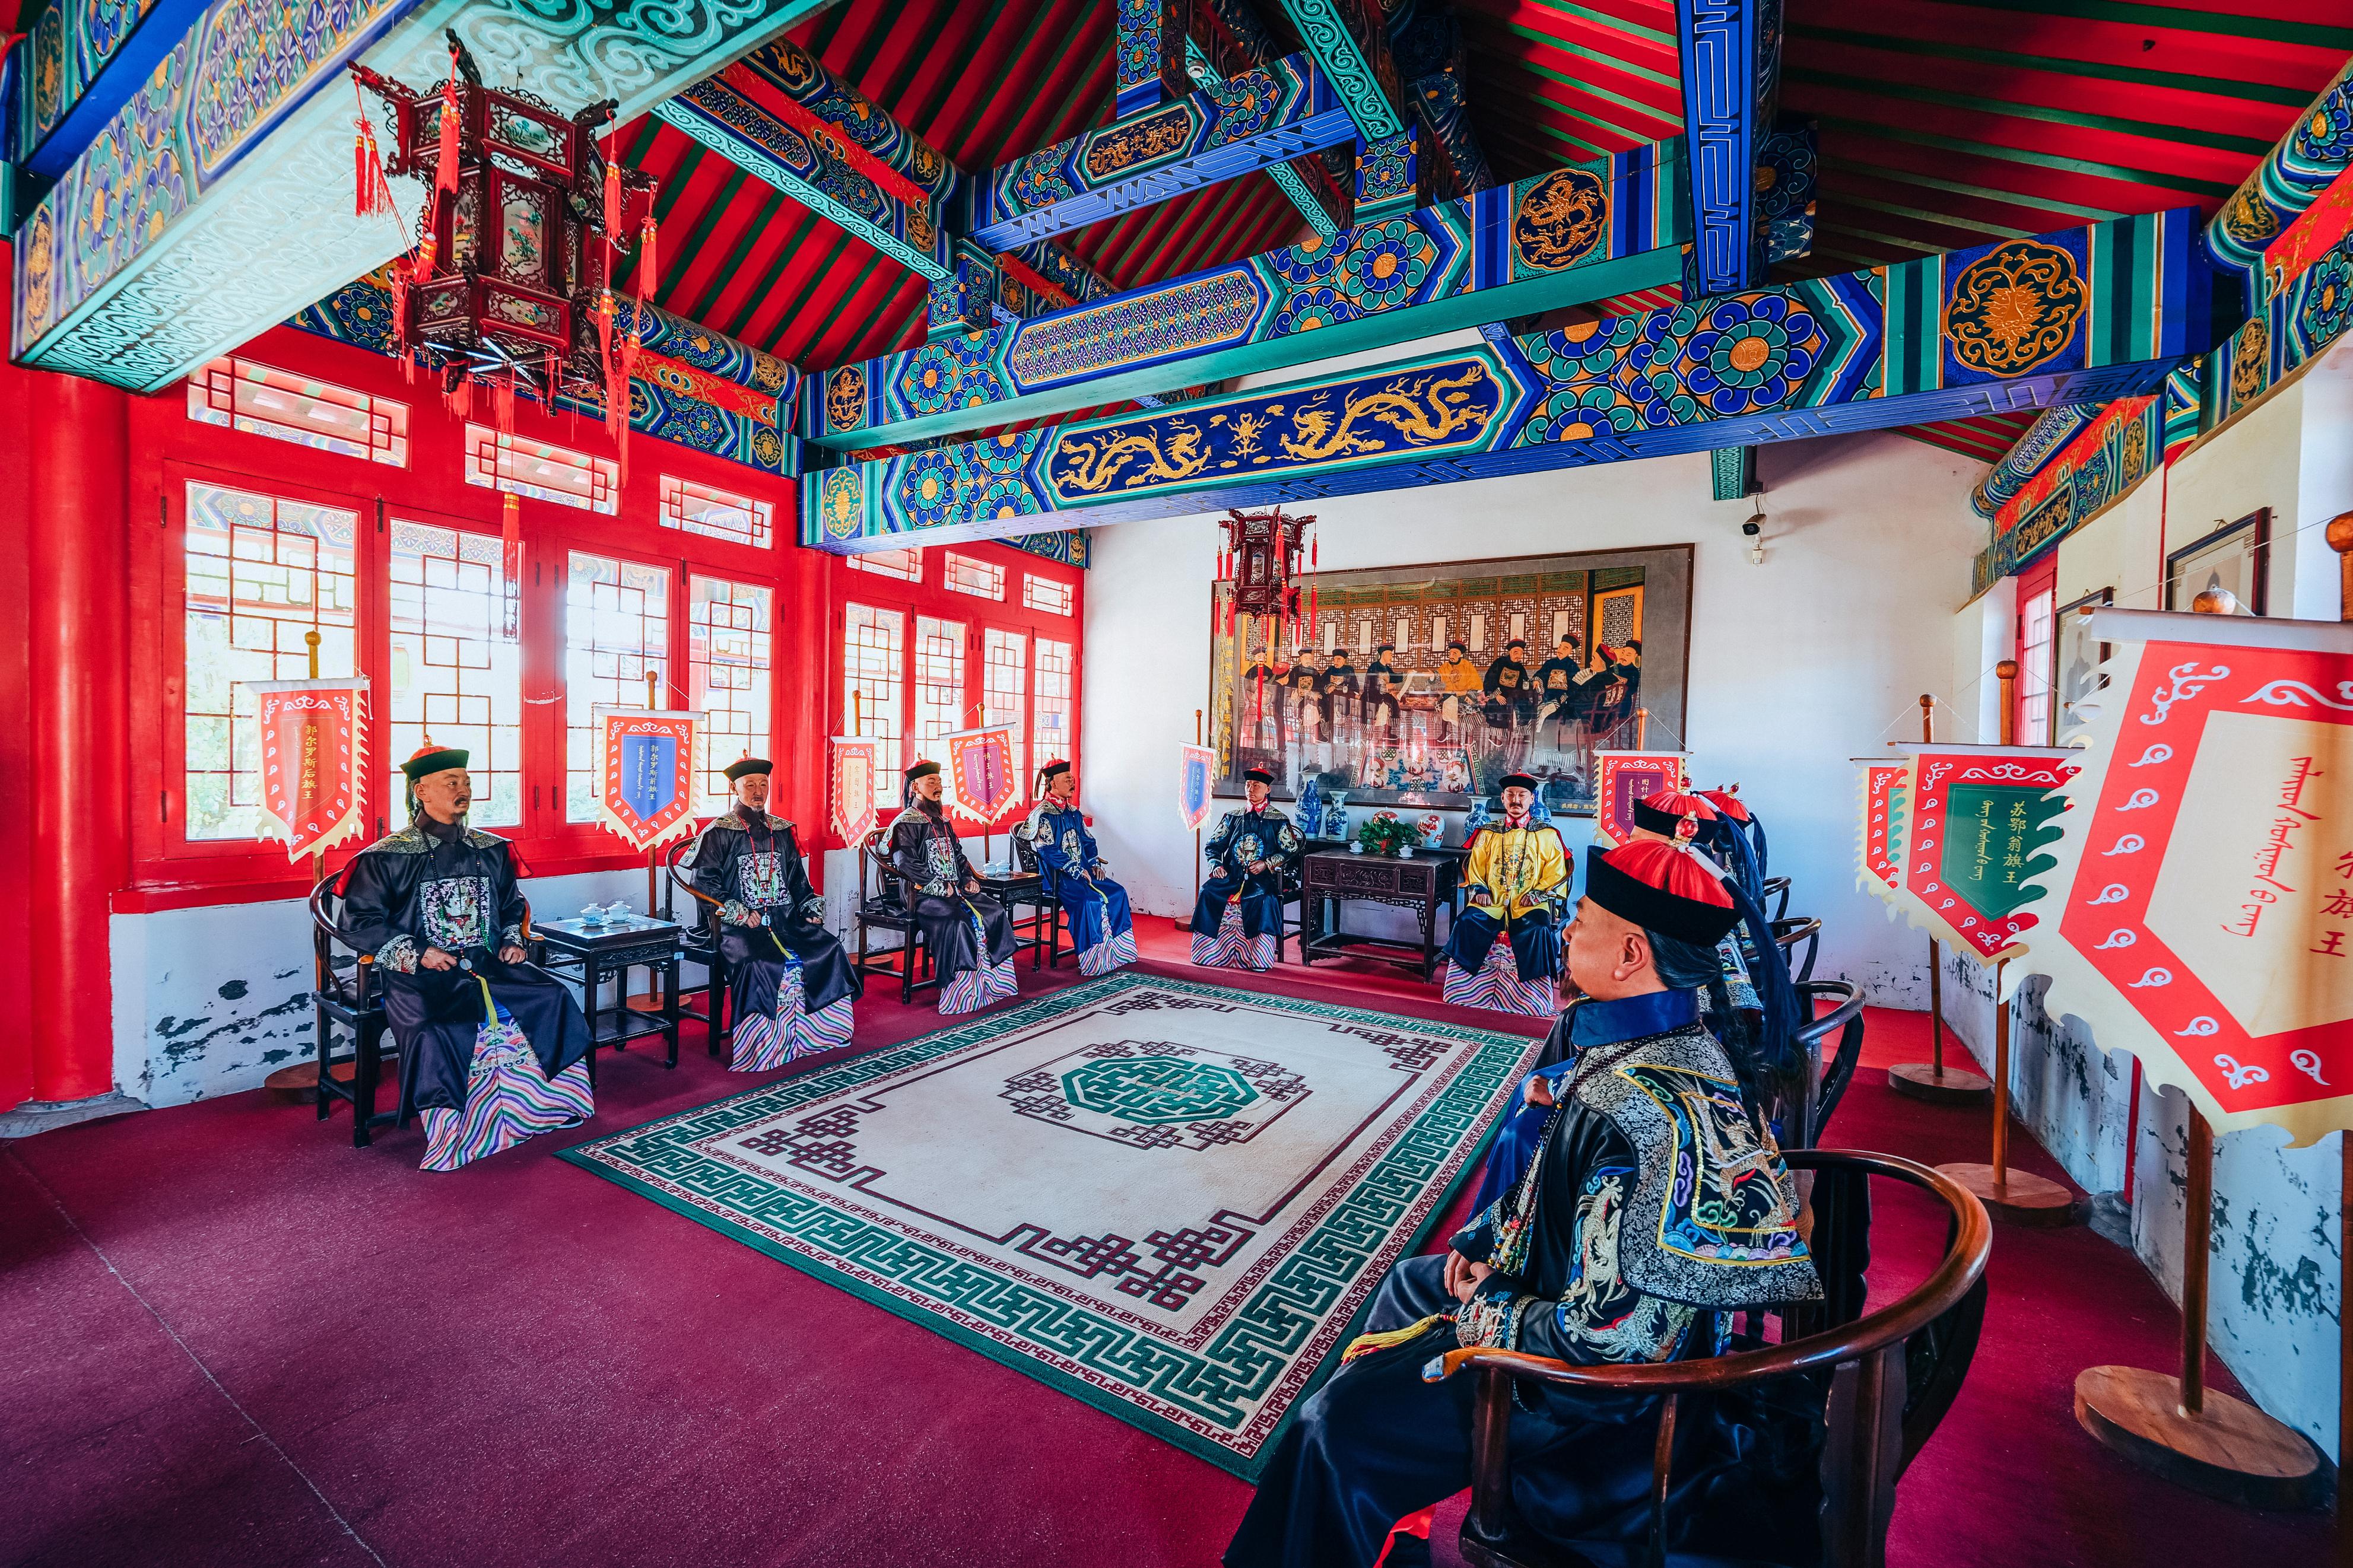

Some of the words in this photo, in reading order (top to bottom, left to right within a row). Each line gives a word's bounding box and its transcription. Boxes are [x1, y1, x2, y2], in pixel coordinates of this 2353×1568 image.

[301, 725, 318, 799] 郭尔罗斯后旗王
[647, 745, 659, 800] 郭尔罗斯前旗王
[2002, 800, 2027, 883] 苏鄂翁旗王
